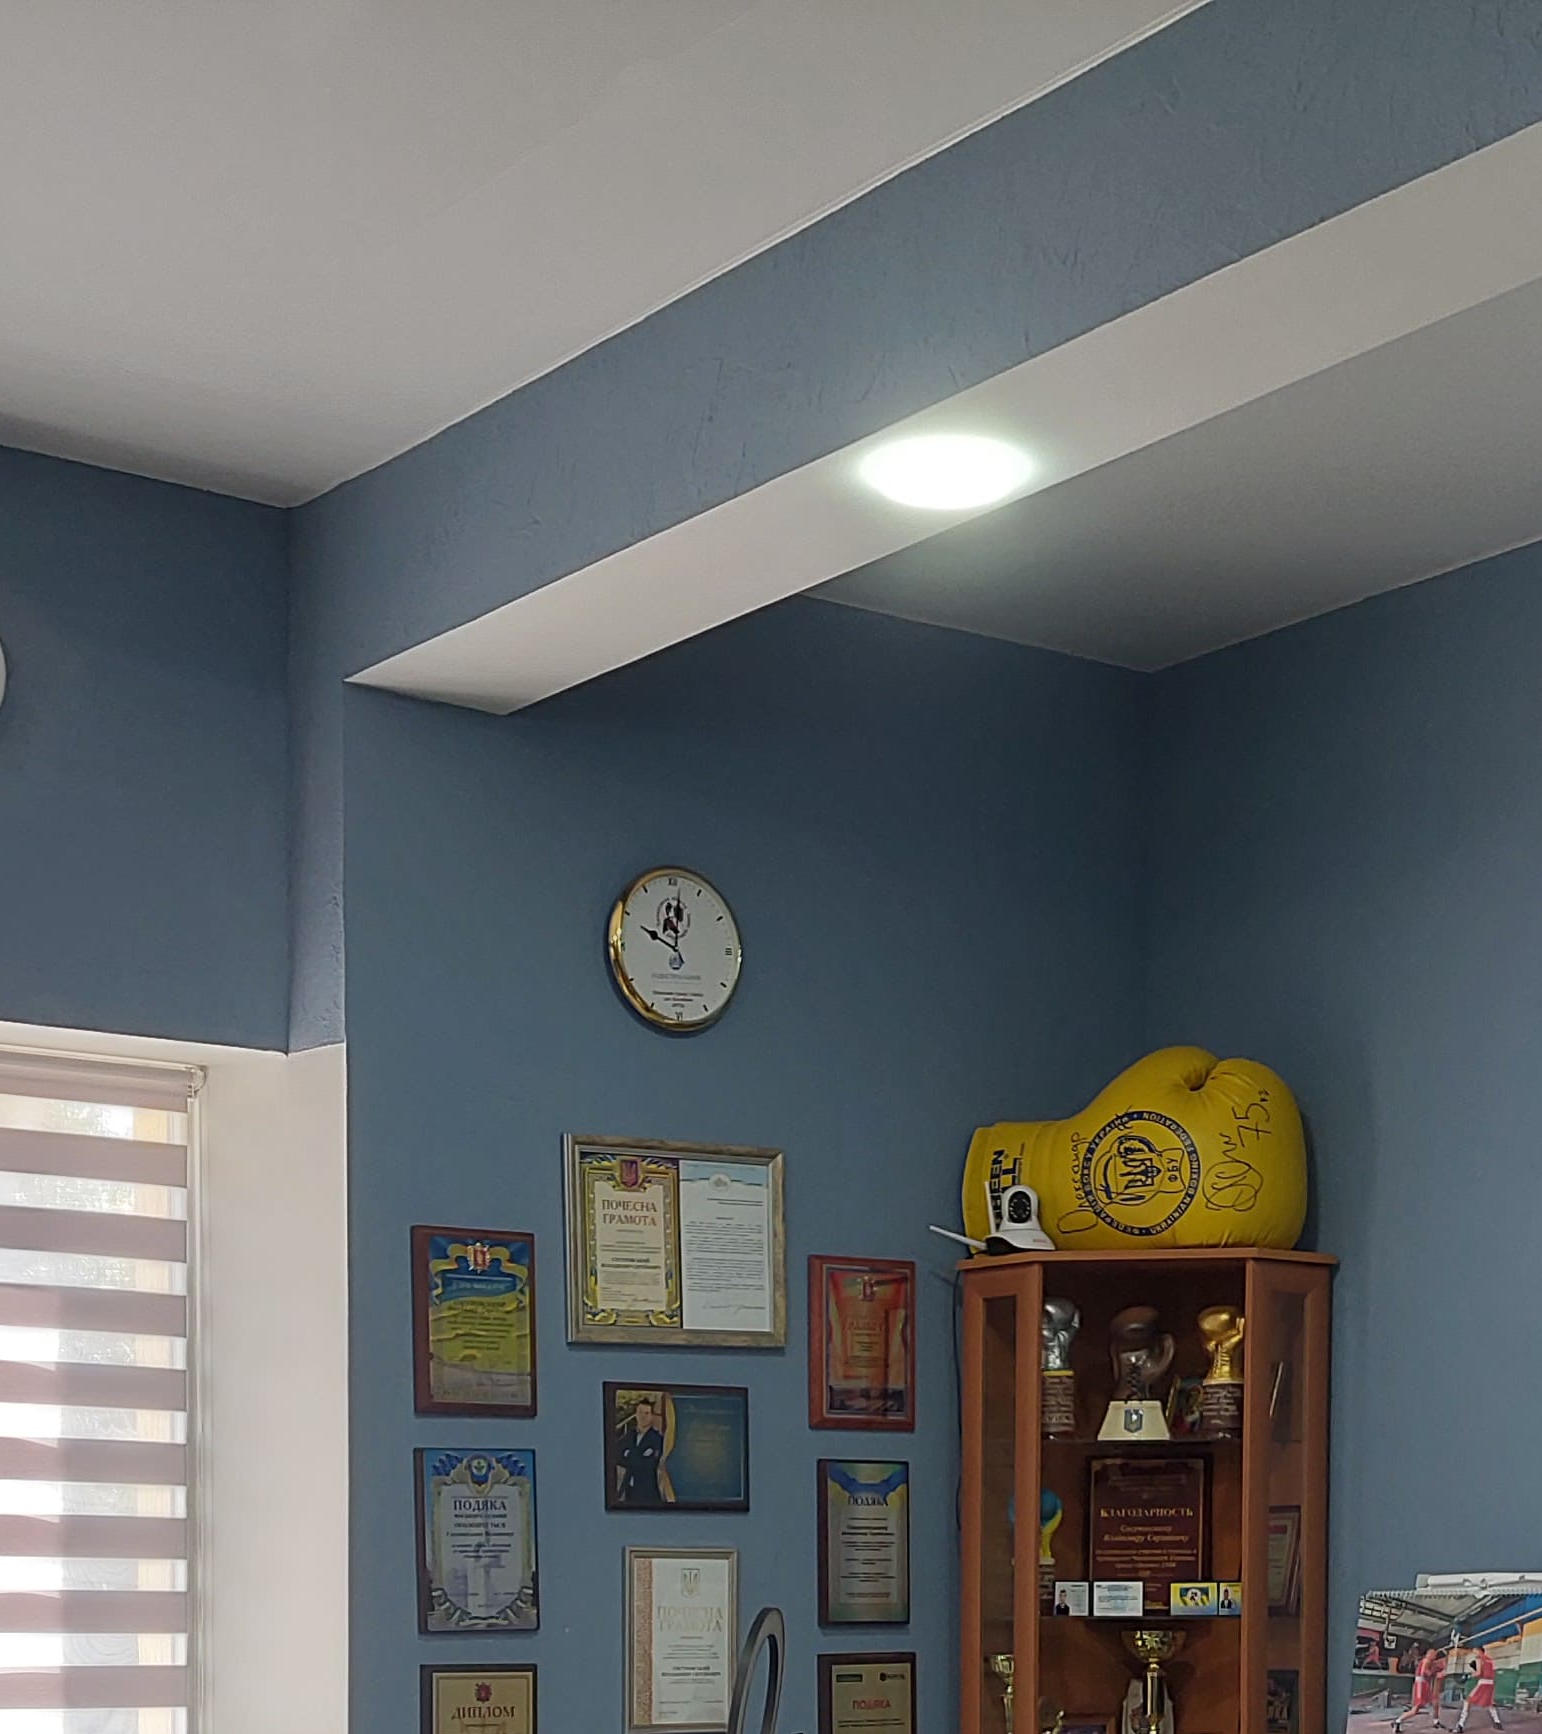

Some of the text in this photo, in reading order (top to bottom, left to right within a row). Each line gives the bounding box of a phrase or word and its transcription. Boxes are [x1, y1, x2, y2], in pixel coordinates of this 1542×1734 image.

[602, 1200, 657, 1213] ПОЧЕСНА
[603, 1214, 657, 1226] ГРАМОТА
[454, 1500, 507, 1512] ПОДЯКА
[451, 1706, 516, 1720] ДИПЛОМ
